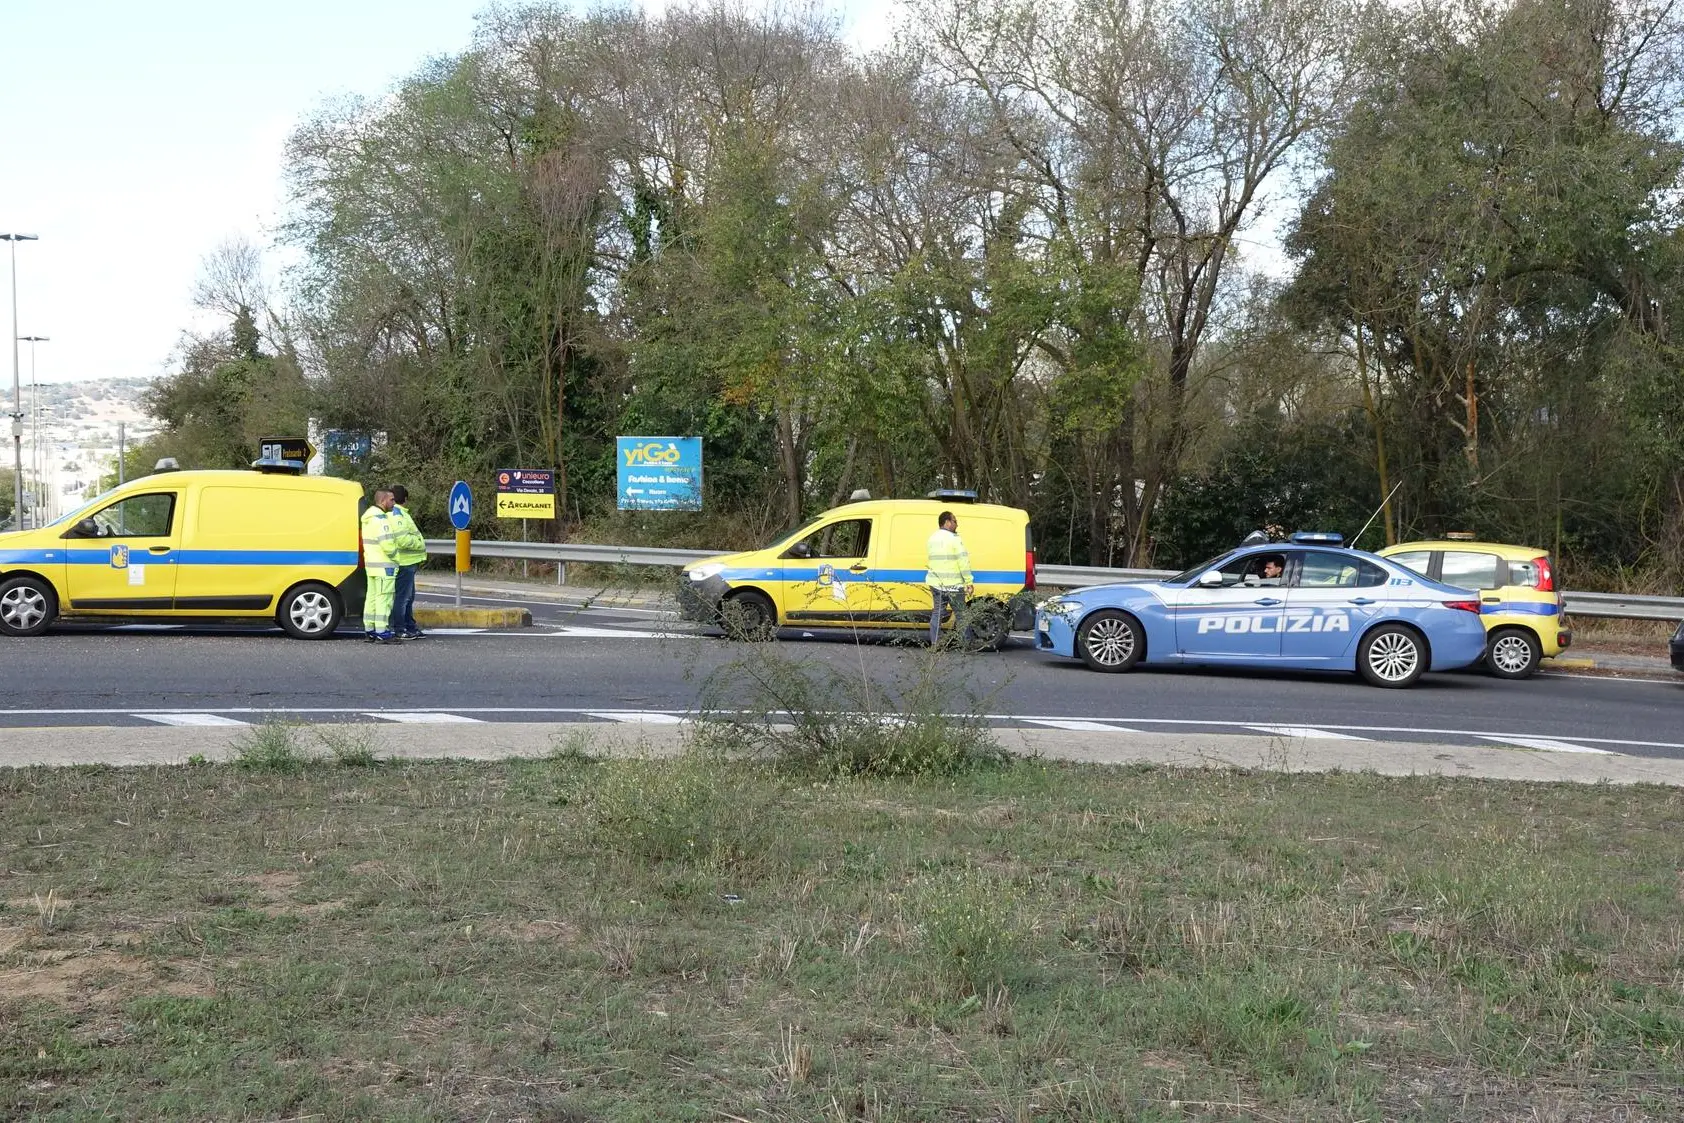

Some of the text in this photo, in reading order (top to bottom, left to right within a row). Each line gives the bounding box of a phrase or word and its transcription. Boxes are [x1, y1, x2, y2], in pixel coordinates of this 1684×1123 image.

[623, 442, 681, 466] yiGò
[522, 472, 550, 480] unieuro
[628, 475, 658, 483] Fashion
[659, 475, 666, 483] &
[507, 500, 551, 509] ARCAPLANET
[1389, 578, 1413, 586] 113
[1197, 614, 1350, 634] POLIZIA
